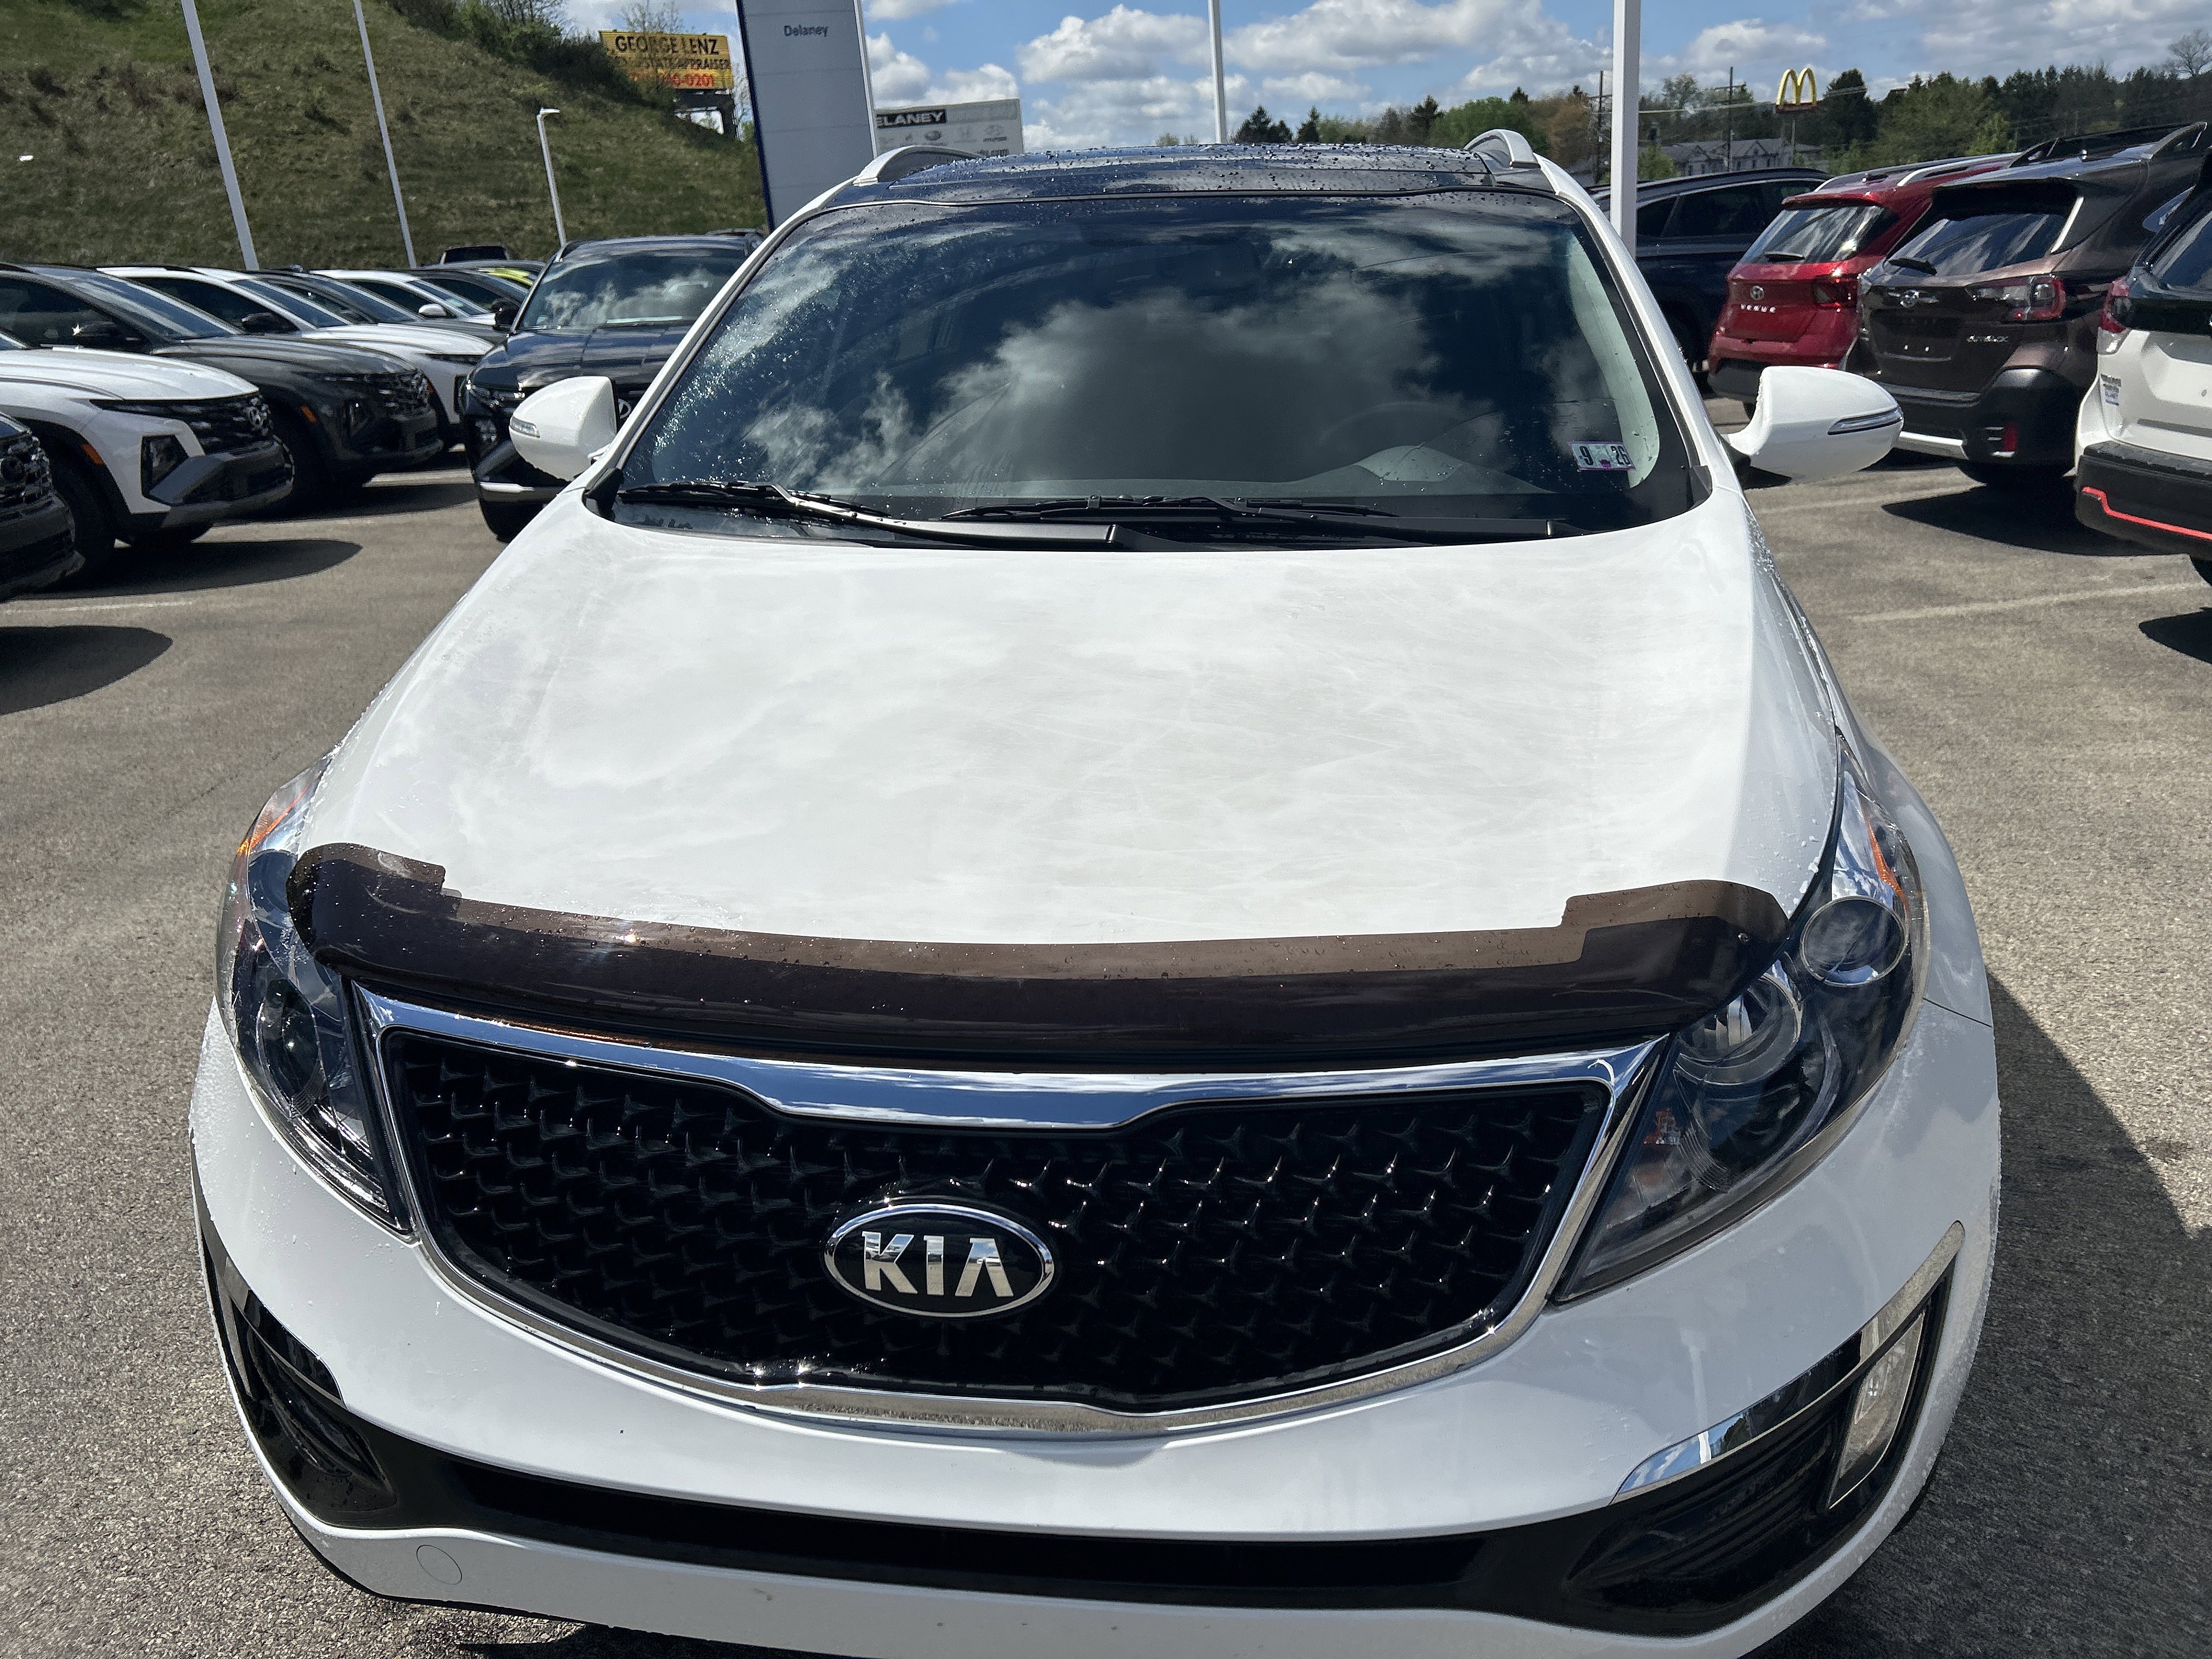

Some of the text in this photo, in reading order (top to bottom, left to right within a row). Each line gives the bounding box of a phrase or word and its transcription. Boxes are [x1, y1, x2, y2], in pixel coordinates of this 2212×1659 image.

[681, 37, 719, 56] LENZ
[876, 111, 944, 126] ELANEY
[1579, 445, 1631, 465] 9 26
[862, 1231, 1014, 1297] KIA
